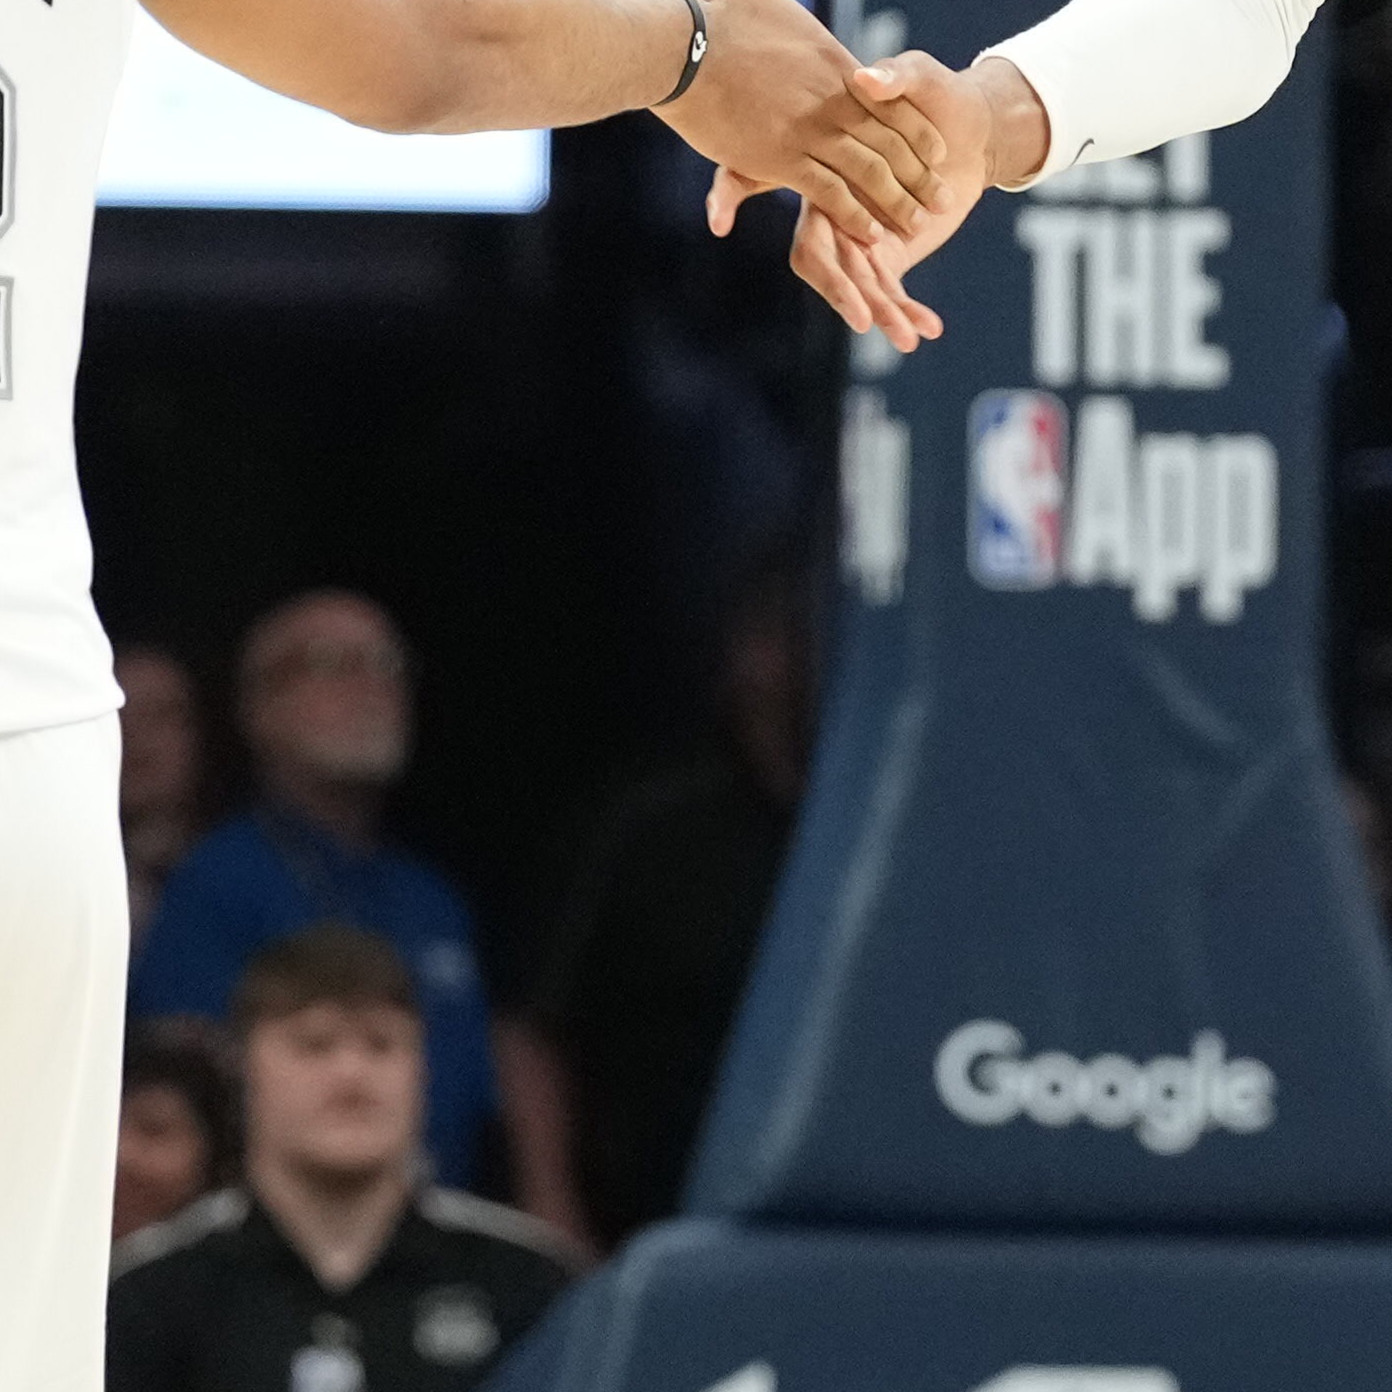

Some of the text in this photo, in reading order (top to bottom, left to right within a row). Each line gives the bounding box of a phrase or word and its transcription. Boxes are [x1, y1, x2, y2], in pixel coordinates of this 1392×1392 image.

[1016, 203, 1230, 389] THE
[1069, 395, 1279, 624] App
[934, 1020, 1275, 1155] Google
